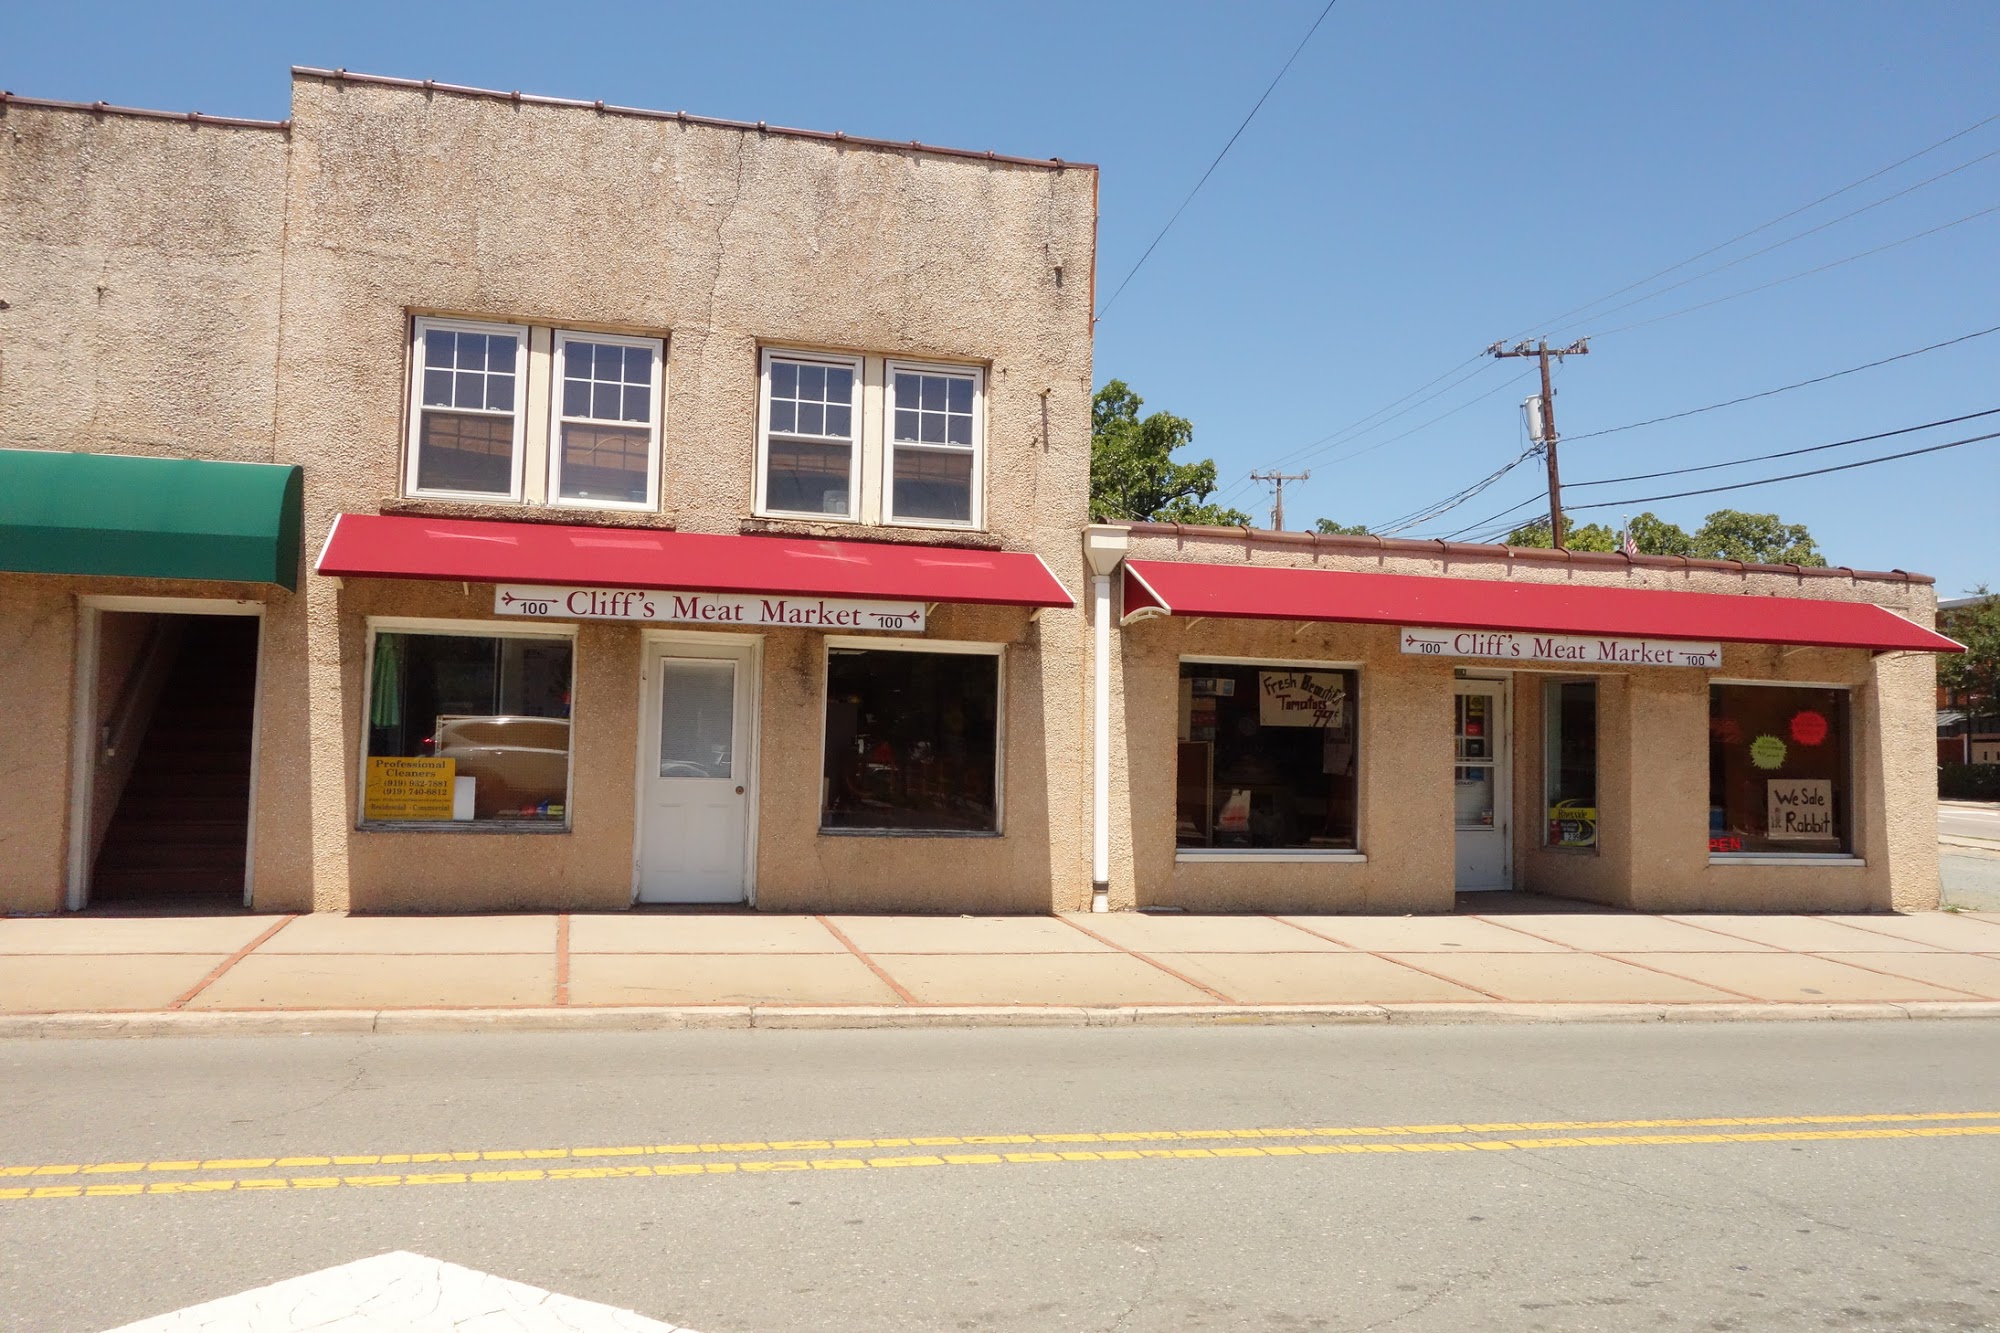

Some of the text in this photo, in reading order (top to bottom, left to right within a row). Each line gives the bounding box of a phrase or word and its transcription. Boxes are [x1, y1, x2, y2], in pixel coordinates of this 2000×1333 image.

[520, 590, 903, 629] 100 Cliff's Meat Market 100
[1419, 633, 1705, 666] 100 Cliff's Meat Market 100
[1263, 672, 1297, 696] Fresh
[376, 760, 446, 768] Professional
[386, 768, 436, 777] Cleaners
[1774, 787, 1825, 806] We Sale
[1785, 811, 1831, 834] Rabbit
